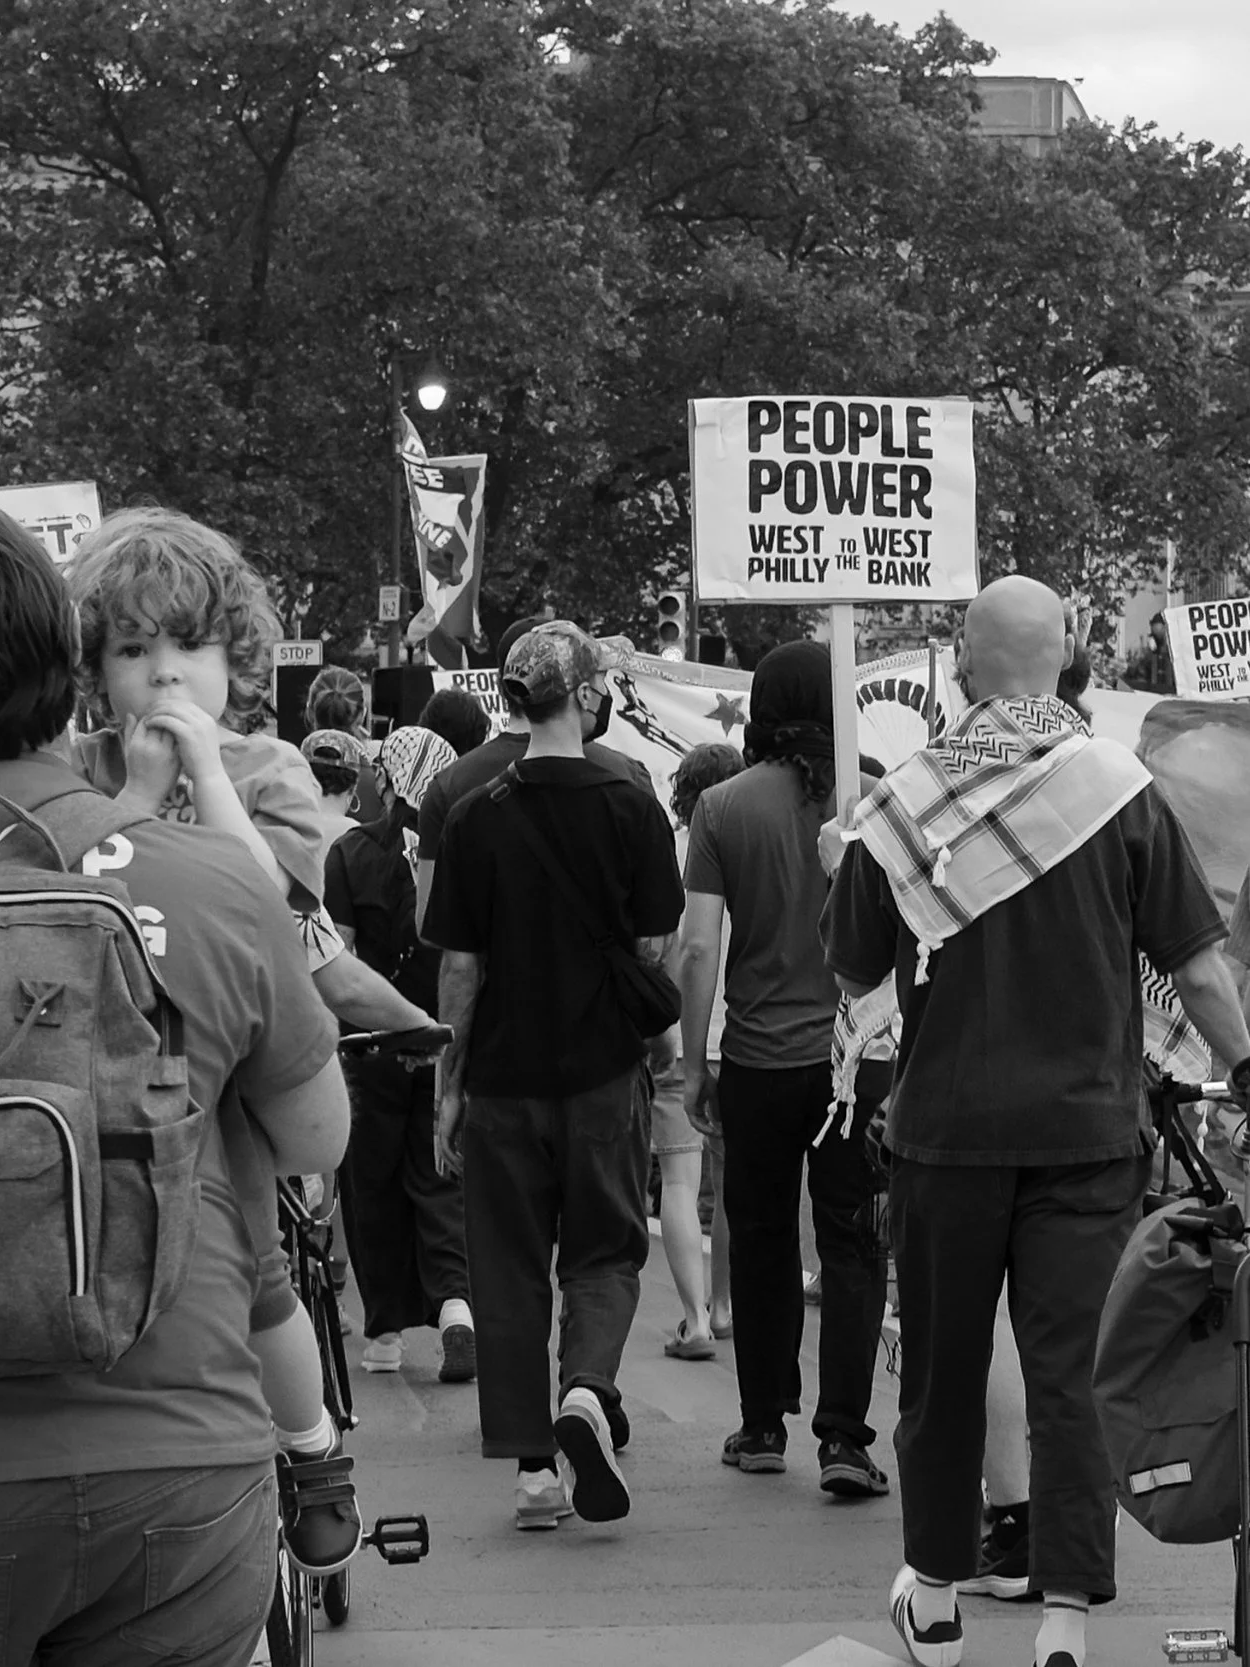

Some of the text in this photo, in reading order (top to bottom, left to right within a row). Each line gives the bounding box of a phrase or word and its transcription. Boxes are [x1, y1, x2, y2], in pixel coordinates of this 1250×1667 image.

[748, 400, 933, 459] PEOPLE
[748, 459, 933, 519] POWER
[748, 524, 932, 558] WEST TO WEST
[748, 555, 931, 587] PHILLY THE BANK
[1188, 601, 1250, 632] PEOP
[279, 646, 314, 660] STOP
[1193, 630, 1250, 661] POW
[1197, 663, 1230, 679] WEST
[1199, 678, 1234, 693] PHILLY
